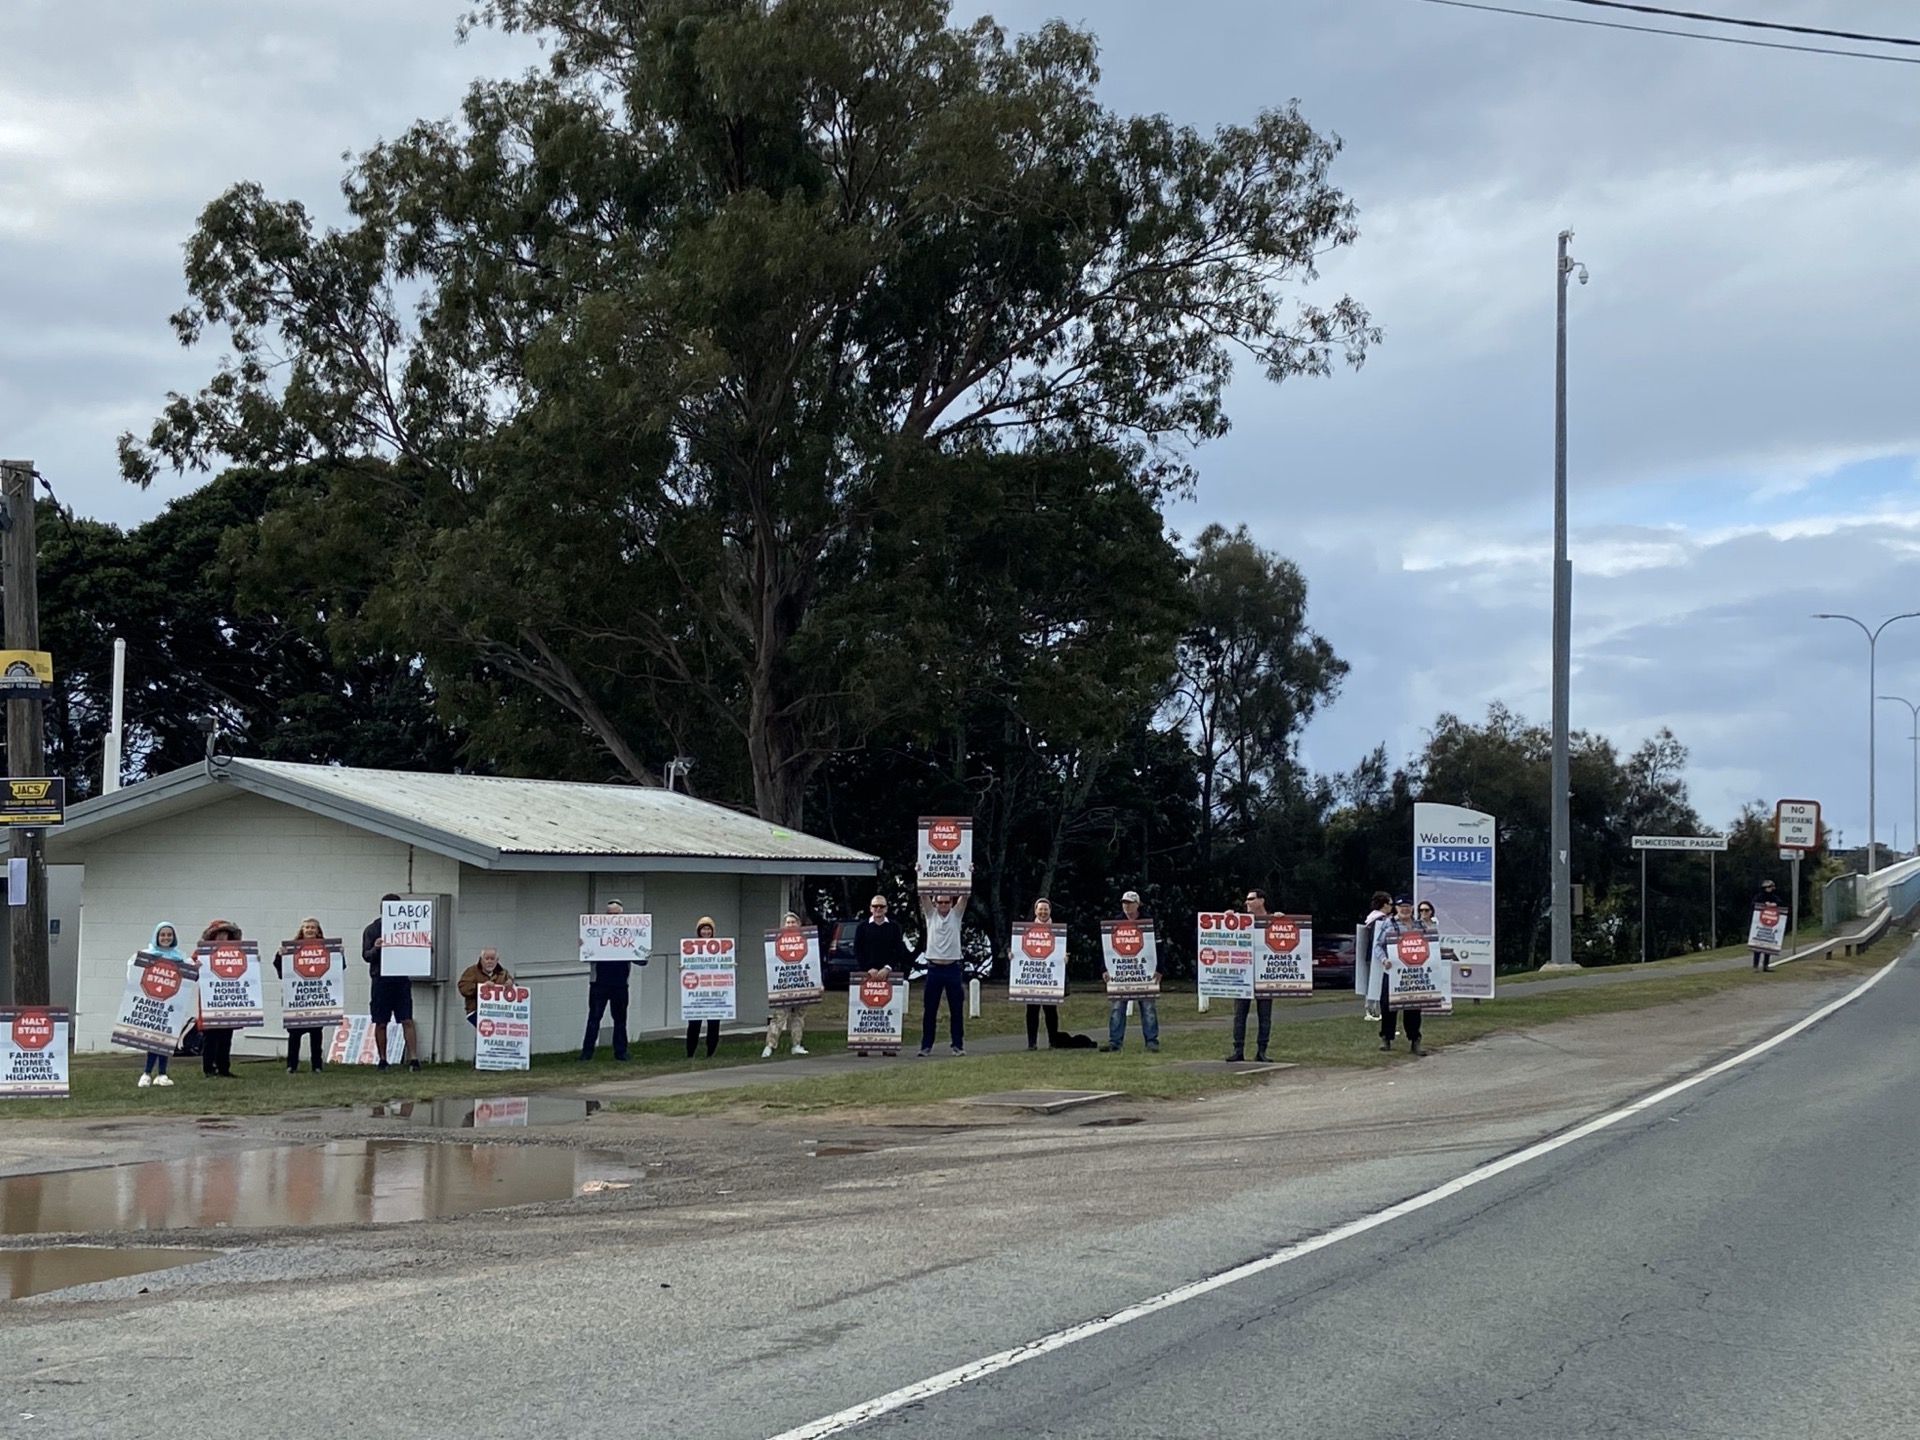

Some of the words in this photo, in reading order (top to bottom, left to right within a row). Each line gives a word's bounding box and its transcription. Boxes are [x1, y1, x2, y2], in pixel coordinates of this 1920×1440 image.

[14, 786, 41, 795] JACS
[1791, 806, 1805, 814] NO
[1420, 833, 1474, 844] Welcome
[1478, 835, 1490, 844] to
[1785, 836, 1808, 844] BRIDGE
[1635, 839, 1686, 847] PUMICESTONE
[1689, 840, 1724, 848] PASSAGE
[1421, 847, 1486, 862] BRIBIE
[388, 904, 430, 918] LABOR
[393, 920, 420, 930] ISN'T
[582, 916, 650, 927] DISINGENUOUS
[1200, 914, 1253, 931] STOP
[600, 936, 635, 948] LABOR
[1026, 939, 1051, 947] STAGE
[682, 940, 733, 955] STOP
[780, 943, 804, 951] STAGE
[1402, 946, 1426, 954] STAGE
[217, 950, 240, 958] HALT
[301, 949, 323, 957] HALT
[215, 958, 243, 966] STAGE
[298, 957, 326, 965] STAGE
[152, 966, 177, 977] HALT
[1397, 967, 1424, 975] FARMS
[146, 974, 177, 987] STAGE
[292, 980, 323, 988] FARMS
[1015, 978, 1058, 986] HIGHWAYS
[1400, 979, 1431, 987] BEFORE
[156, 985, 162, 993] 4
[296, 986, 329, 994] HOMES
[773, 982, 815, 990] HIGHWAYS
[1394, 984, 1436, 993] HIGHWAYS
[295, 993, 330, 1001] BEFORE
[480, 985, 529, 1003] STOP
[133, 996, 166, 1010] FARMS
[167, 1005, 175, 1013] &
[289, 999, 337, 1008] HIGHWAYS
[135, 1004, 170, 1018] HOMES
[22, 1018, 47, 1026] HALT
[131, 1011, 169, 1025] BEFORE
[123, 1016, 173, 1034] HIGHWAYS
[484, 1039, 504, 1047] PLEASE
[12, 1066, 53, 1074] BEFORE
